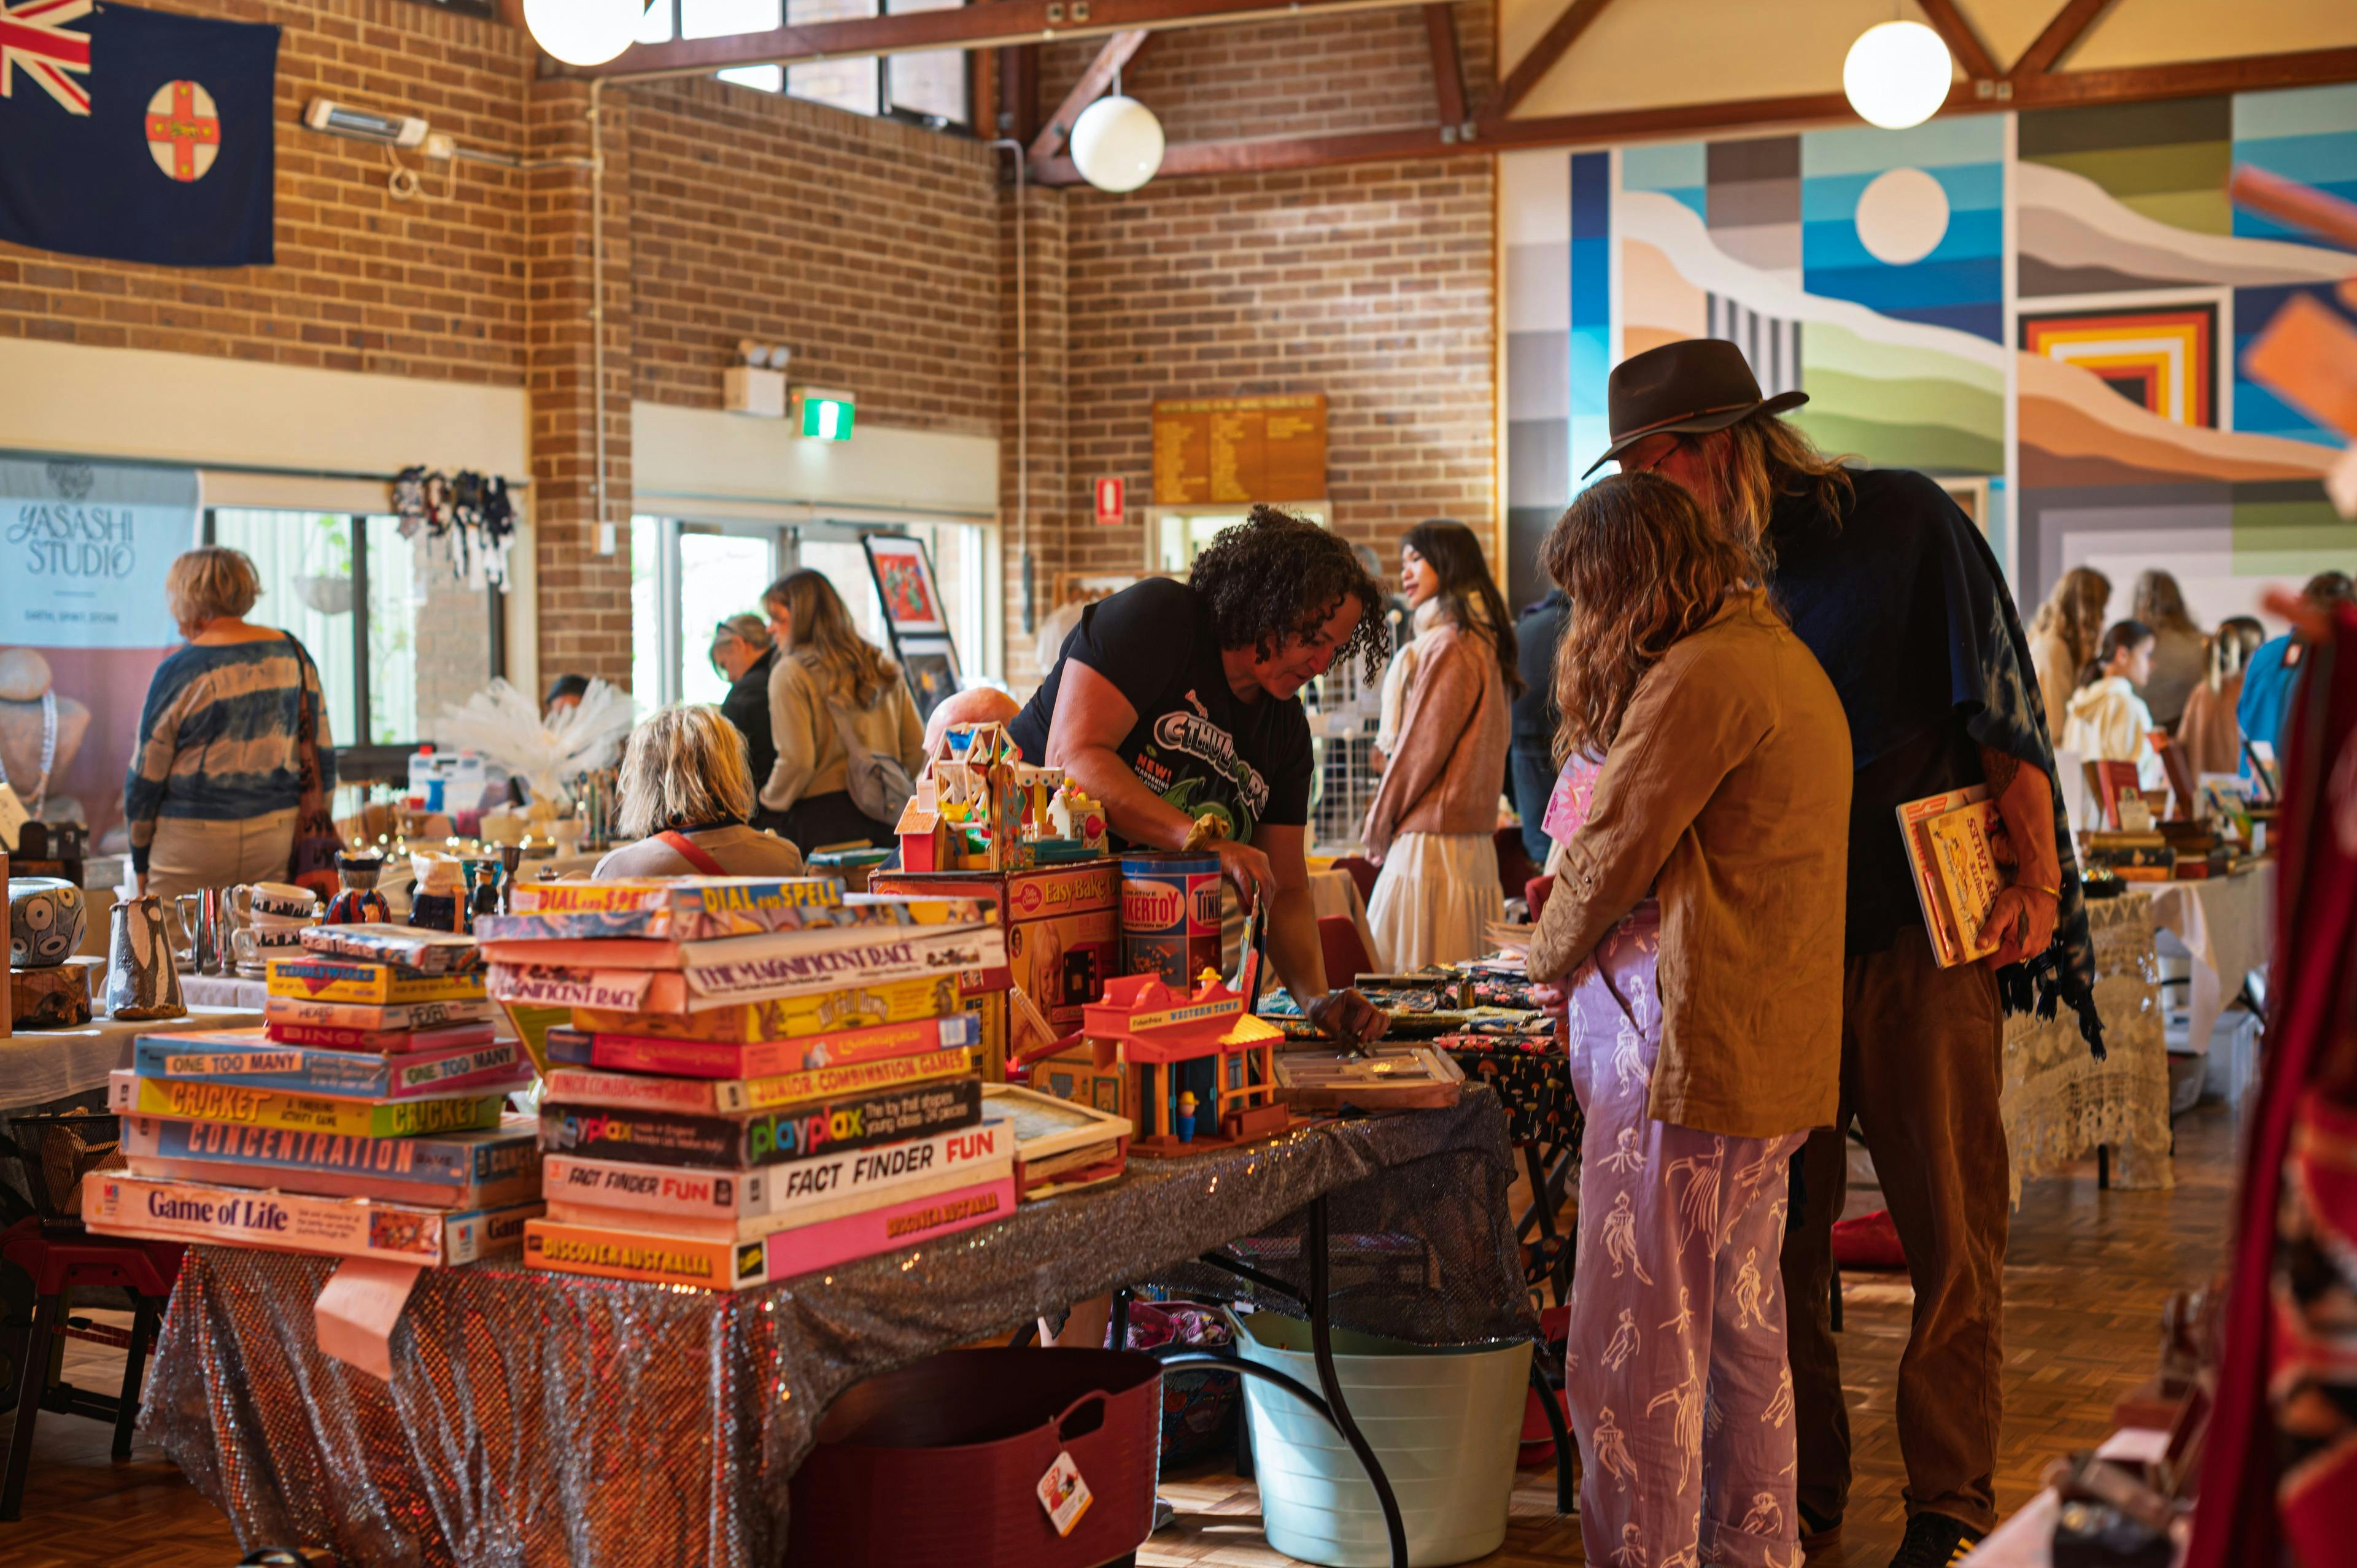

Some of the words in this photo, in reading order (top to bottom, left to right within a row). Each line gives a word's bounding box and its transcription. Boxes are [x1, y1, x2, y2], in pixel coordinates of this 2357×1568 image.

[6, 504, 134, 544] YASASHI
[26, 540, 136, 579] STUDIO
[1134, 765, 1169, 790] MADDENING
[1136, 752, 1172, 784] NEW!
[1967, 817, 1991, 875] TALES
[538, 889, 578, 911] DIAL
[702, 886, 756, 913] DIAL
[779, 879, 840, 911] SPELL
[1123, 891, 1179, 923] NKERTOY
[696, 965, 733, 987] THE
[738, 947, 866, 982] MAGNIFICENT
[867, 942, 916, 967] RACE
[595, 986, 637, 1008] RACE
[1170, 1005, 1212, 1021] WESTERN
[1214, 1000, 1239, 1014] TOWN
[172, 1057, 205, 1073] ONE
[212, 1056, 244, 1072] TOO
[250, 1053, 296, 1070] MANY
[406, 1063, 437, 1085] ONE
[441, 1059, 470, 1078] TOO
[473, 1047, 513, 1070] MANY
[757, 1076, 813, 1102] JUNIOR
[818, 1059, 918, 1092] COMBINATION
[919, 1049, 965, 1075] GAMES
[170, 1081, 273, 1122] CRICKET
[392, 1096, 488, 1133] CRICKET
[187, 1120, 416, 1173] CONCENTRATION
[555, 1112, 632, 1144] ayplax
[751, 1105, 865, 1163] playplax
[786, 1162, 844, 1199] FACT
[853, 1143, 935, 1186] FINDER
[946, 1130, 994, 1164] FUN
[568, 1167, 602, 1188] FACT
[604, 1171, 660, 1197] FINDER
[662, 1178, 710, 1201] FUN
[147, 1189, 214, 1223] Game
[217, 1199, 239, 1227] of
[244, 1200, 289, 1232] Life
[886, 1209, 941, 1239] DISCOVER
[941, 1192, 999, 1223] AUSTRALIA
[542, 1237, 621, 1267] DISCOVER
[621, 1246, 713, 1279] AUSTRALIA
